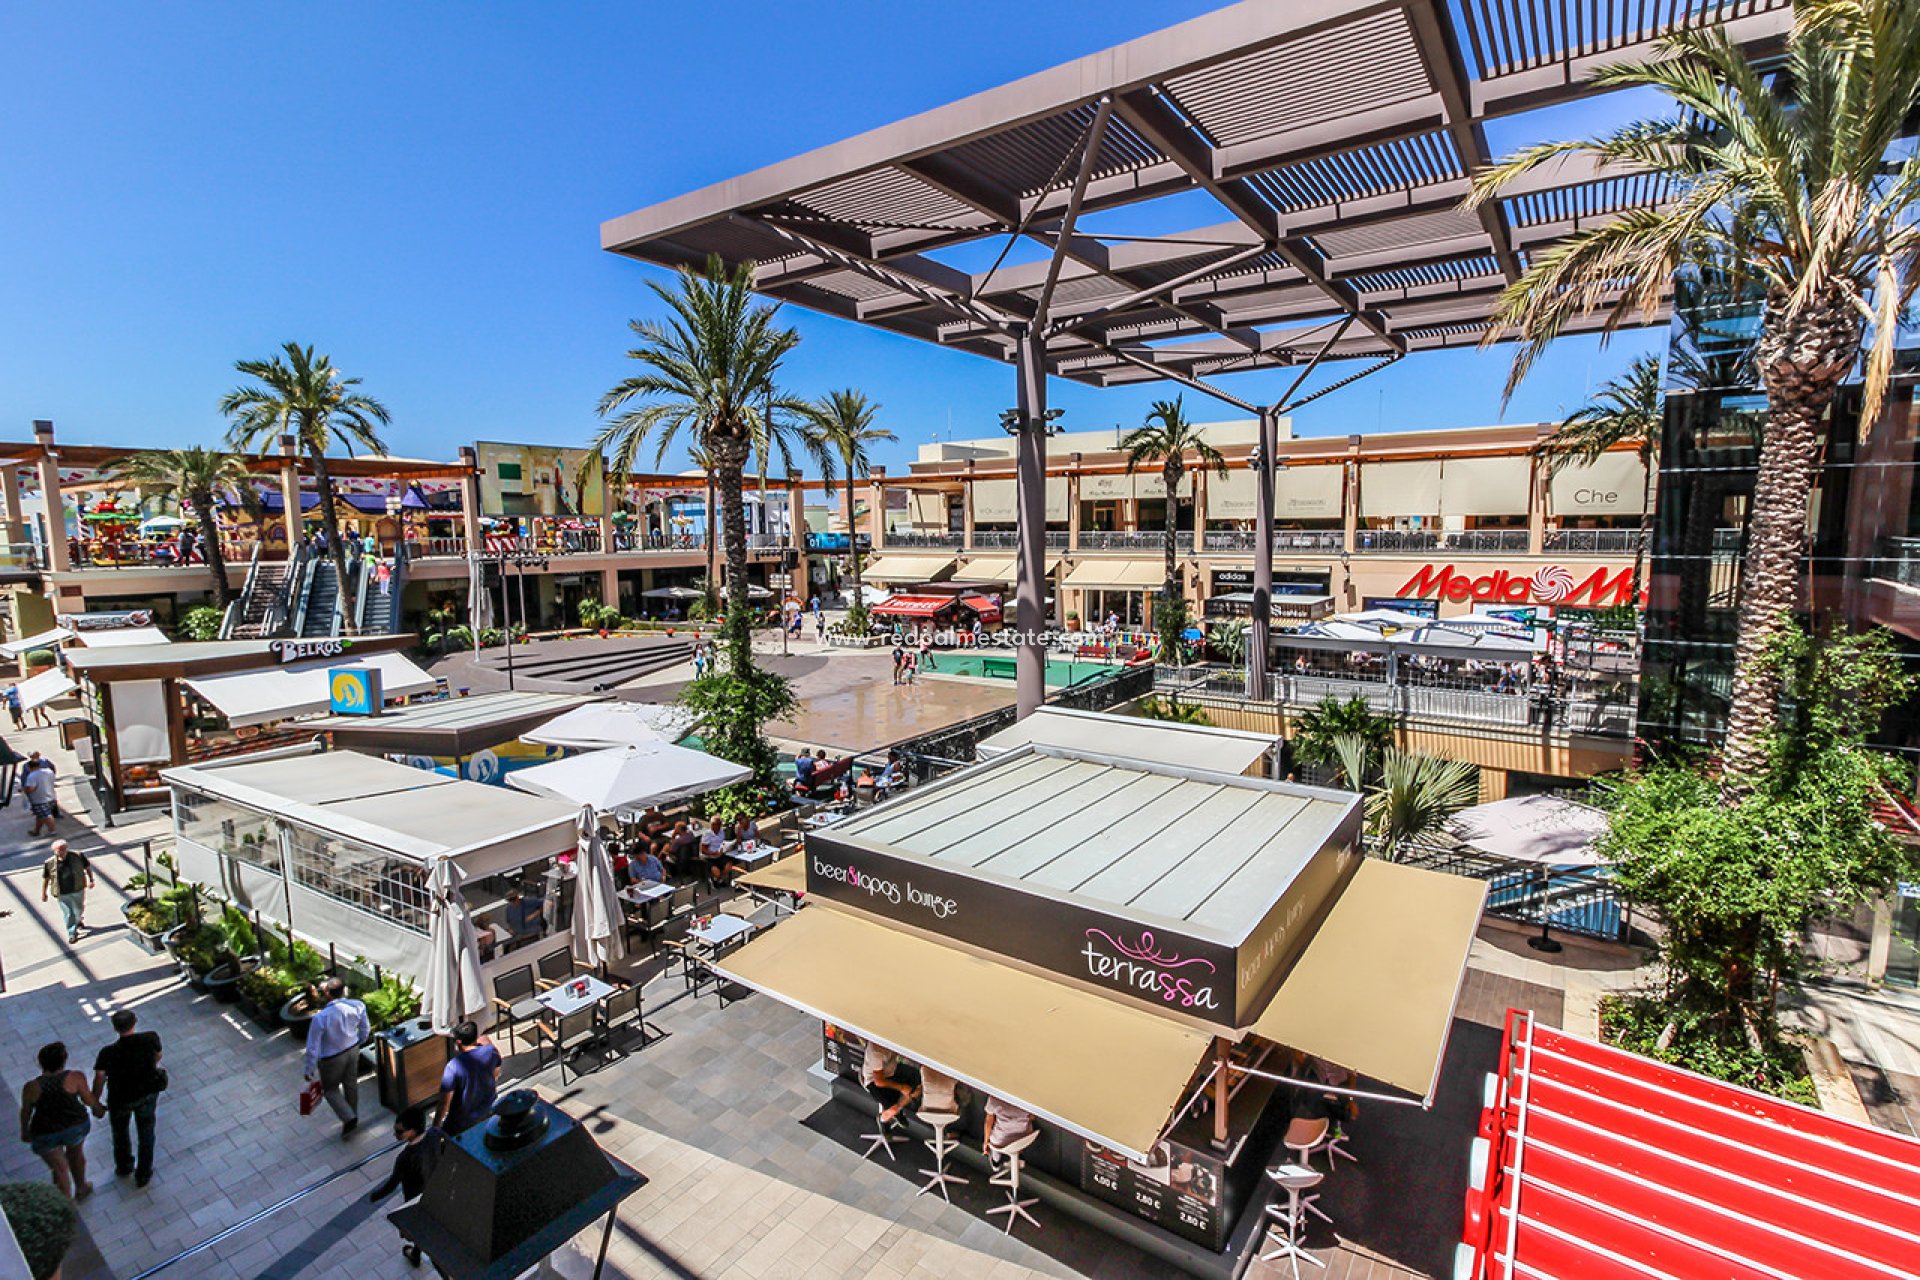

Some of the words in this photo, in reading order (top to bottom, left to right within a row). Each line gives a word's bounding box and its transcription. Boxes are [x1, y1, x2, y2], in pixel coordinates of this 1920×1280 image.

[1574, 488, 1618, 505] Che
[1219, 572, 1247, 581] adidas
[1395, 564, 1534, 602] Media
[813, 855, 901, 904] beer&tapas
[907, 881, 958, 919] lounge
[1081, 941, 1219, 1010] terrassa
